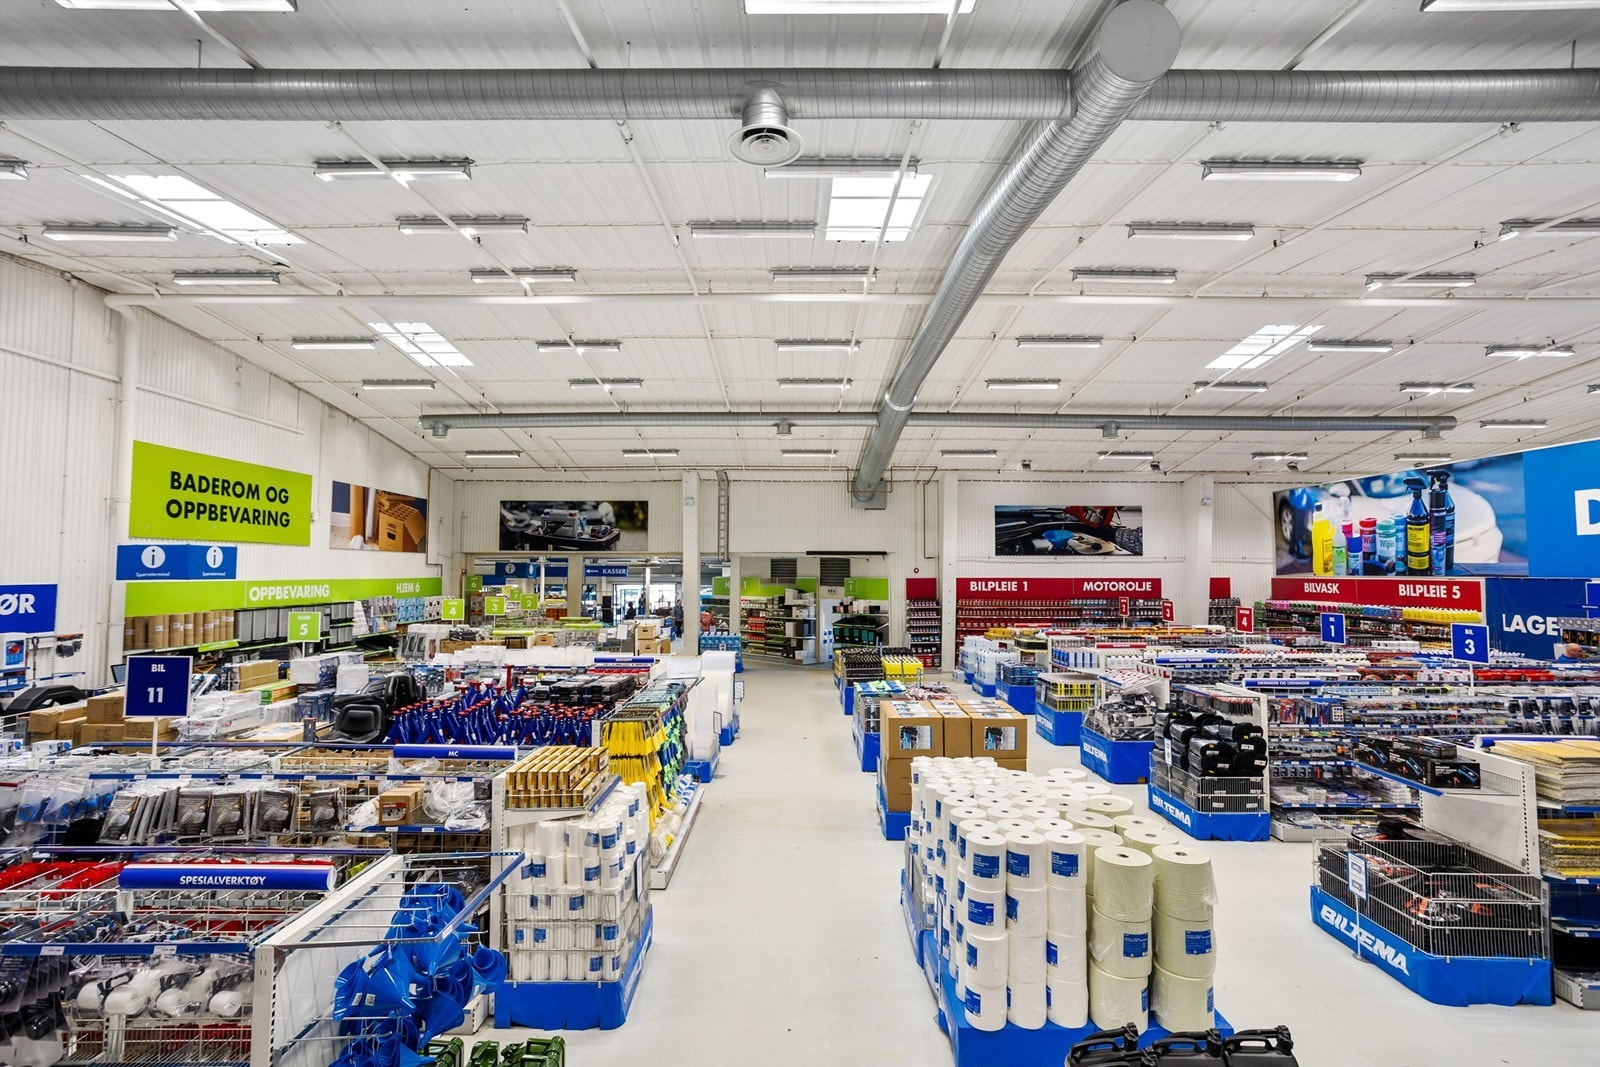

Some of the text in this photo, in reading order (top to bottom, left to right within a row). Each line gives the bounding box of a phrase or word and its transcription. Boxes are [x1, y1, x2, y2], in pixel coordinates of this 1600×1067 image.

[170, 471, 289, 504] BADEROM OG
[166, 499, 290, 528] OPPBEVARING
[249, 582, 420, 601] OPPBEVARING HJEM 6
[970, 581, 1028, 592] BILPLEIE 1
[1083, 581, 1152, 592] MOTOROLJE
[1304, 582, 1340, 595] BILVASK
[1399, 584, 1461, 599] BILPLEIE 5
[449, 607, 457, 615] 4
[491, 603, 498, 611] 3
[1241, 616, 1248, 627] 4
[1502, 613, 1562, 636] LAGE
[299, 623, 309, 635] 5
[1330, 625, 1335, 637] 1
[1464, 638, 1475, 655] 3
[151, 664, 166, 673] BIL
[147, 687, 163, 703] 11
[1083, 741, 1108, 763] BILTEMA
[1152, 794, 1192, 828] BILTEMA
[180, 875, 266, 886] SPESIALVERKTØY
[1320, 904, 1410, 976] BILTEMA
